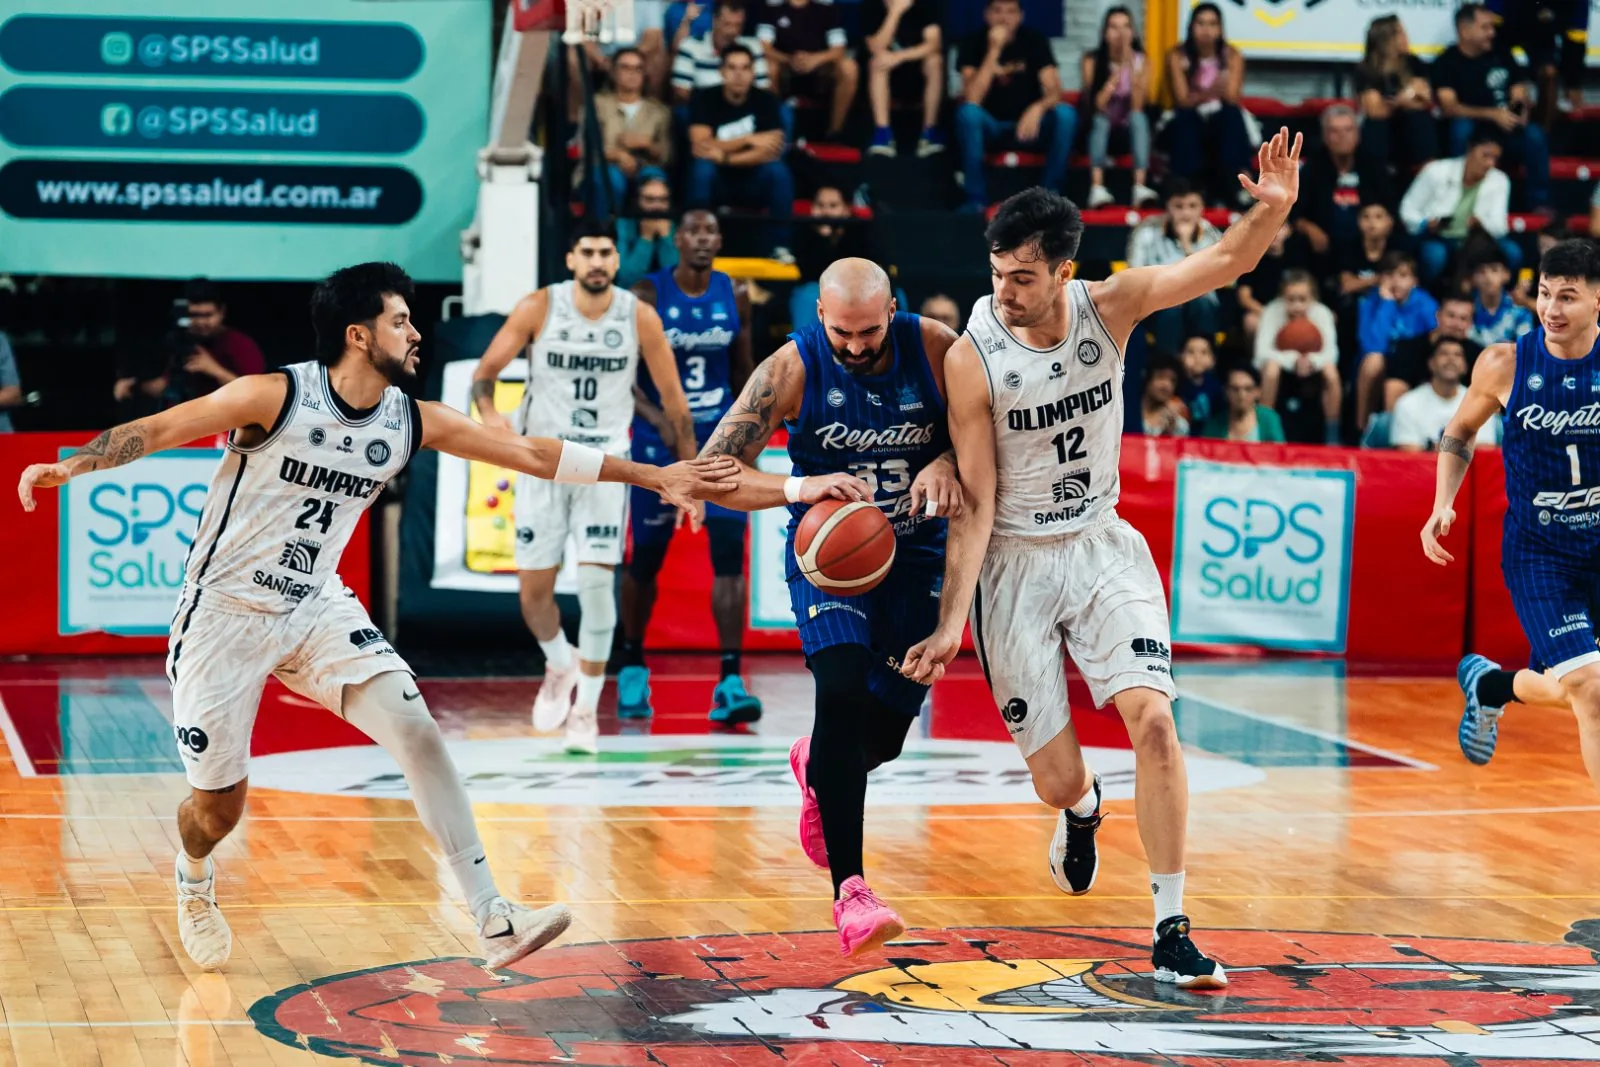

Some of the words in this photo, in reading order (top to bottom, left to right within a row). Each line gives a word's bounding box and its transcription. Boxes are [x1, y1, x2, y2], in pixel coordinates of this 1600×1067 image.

[138, 33, 321, 67] @SPSSalud
[137, 105, 319, 139] @SPSSalud
[36, 177, 382, 210] www.spssalud.com.ar
[546, 351, 628, 372] OLIMPICO
[685, 356, 706, 389] 3
[572, 377, 598, 401] 10
[1007, 378, 1113, 431] OLIMPICO
[815, 421, 935, 452] Regatas
[1516, 403, 1600, 436] Regata
[1051, 426, 1088, 465] 12
[848, 458, 911, 497] 33
[1565, 444, 1581, 486] 1
[87, 483, 208, 547] SPS
[294, 497, 339, 534] 24
[1201, 497, 1326, 565] SPS
[1552, 510, 1600, 526] CORRIEN
[88, 551, 184, 588] Salu
[1200, 561, 1323, 605] Salud
